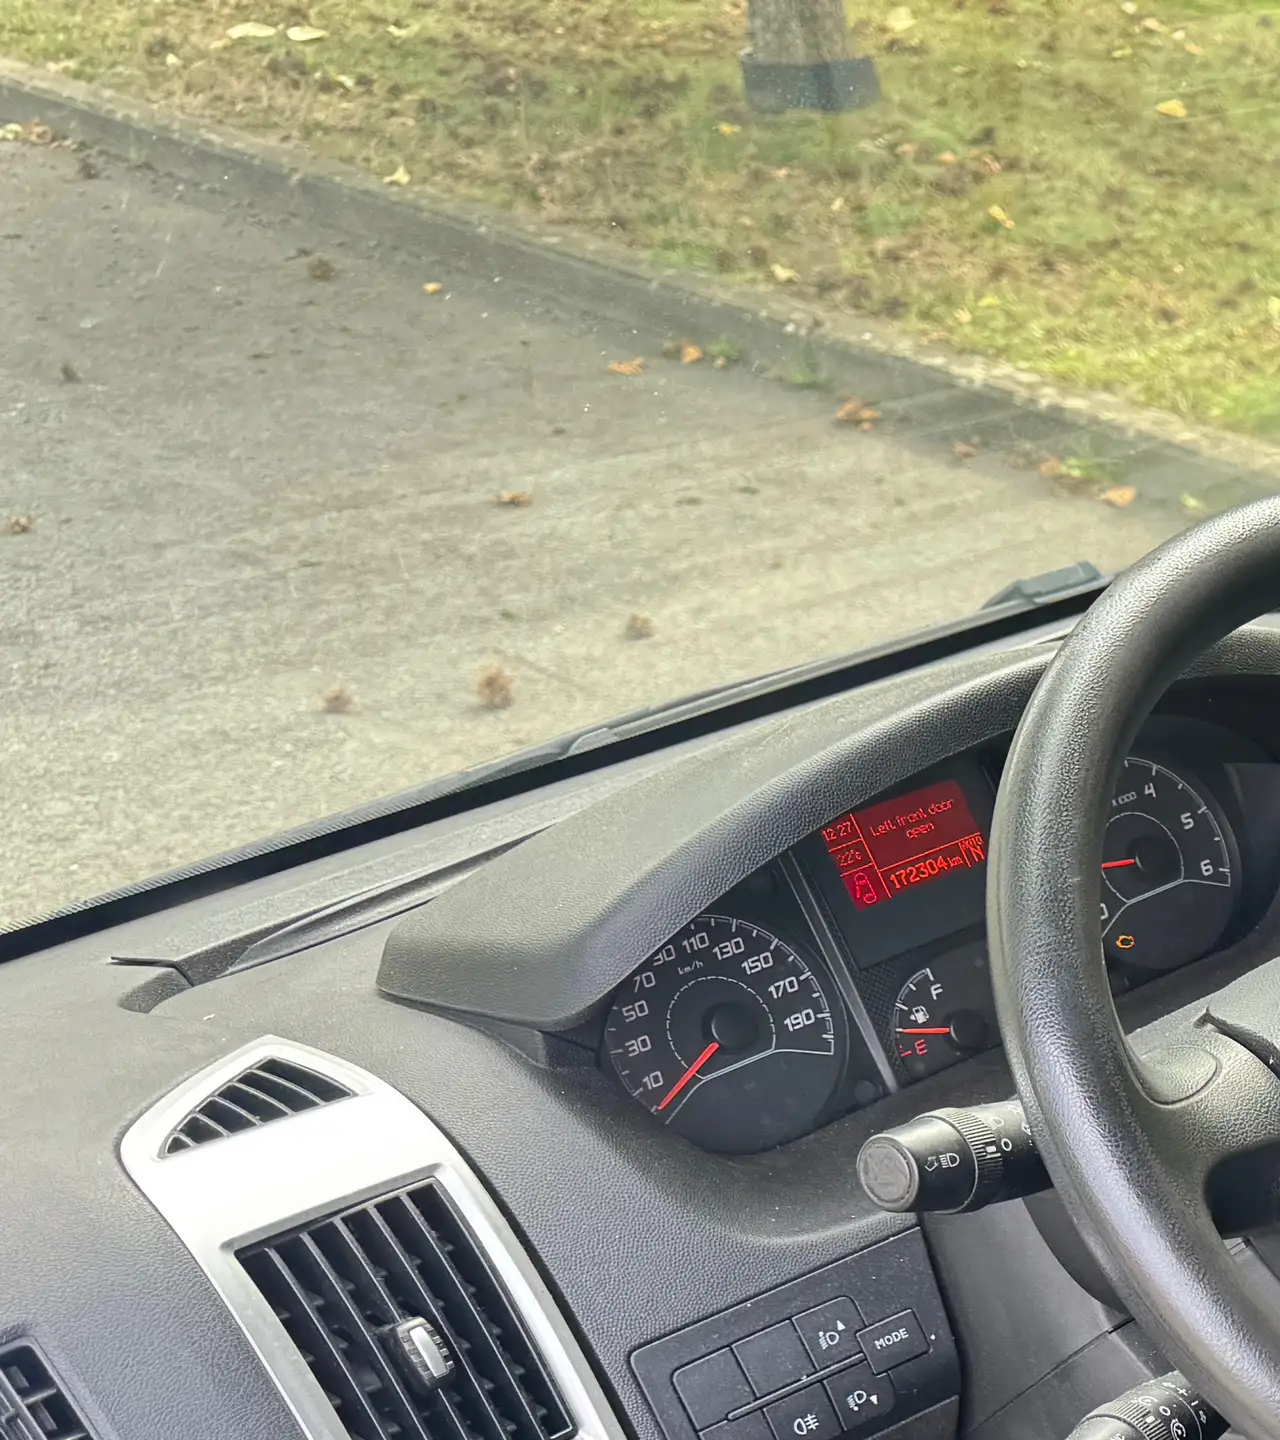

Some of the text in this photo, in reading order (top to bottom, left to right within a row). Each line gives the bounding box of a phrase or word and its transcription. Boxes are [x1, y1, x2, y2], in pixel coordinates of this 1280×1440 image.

[1144, 783, 1157, 798] 4
[906, 823, 934, 839] open
[1180, 812, 1195, 830] 5
[970, 845, 985, 862] N
[890, 855, 947, 889] 172304
[1200, 859, 1214, 876] 6
[682, 931, 709, 954] 110
[712, 937, 745, 961] 130
[740, 951, 774, 976] 150
[633, 972, 656, 993] 70
[768, 975, 799, 1000] 170
[931, 984, 943, 1000] F
[622, 999, 649, 1023] 50
[784, 1008, 816, 1033] 190
[625, 1035, 651, 1057] 30
[914, 1038, 928, 1055] E
[642, 1071, 664, 1090] 10
[875, 1327, 909, 1350] MODE
